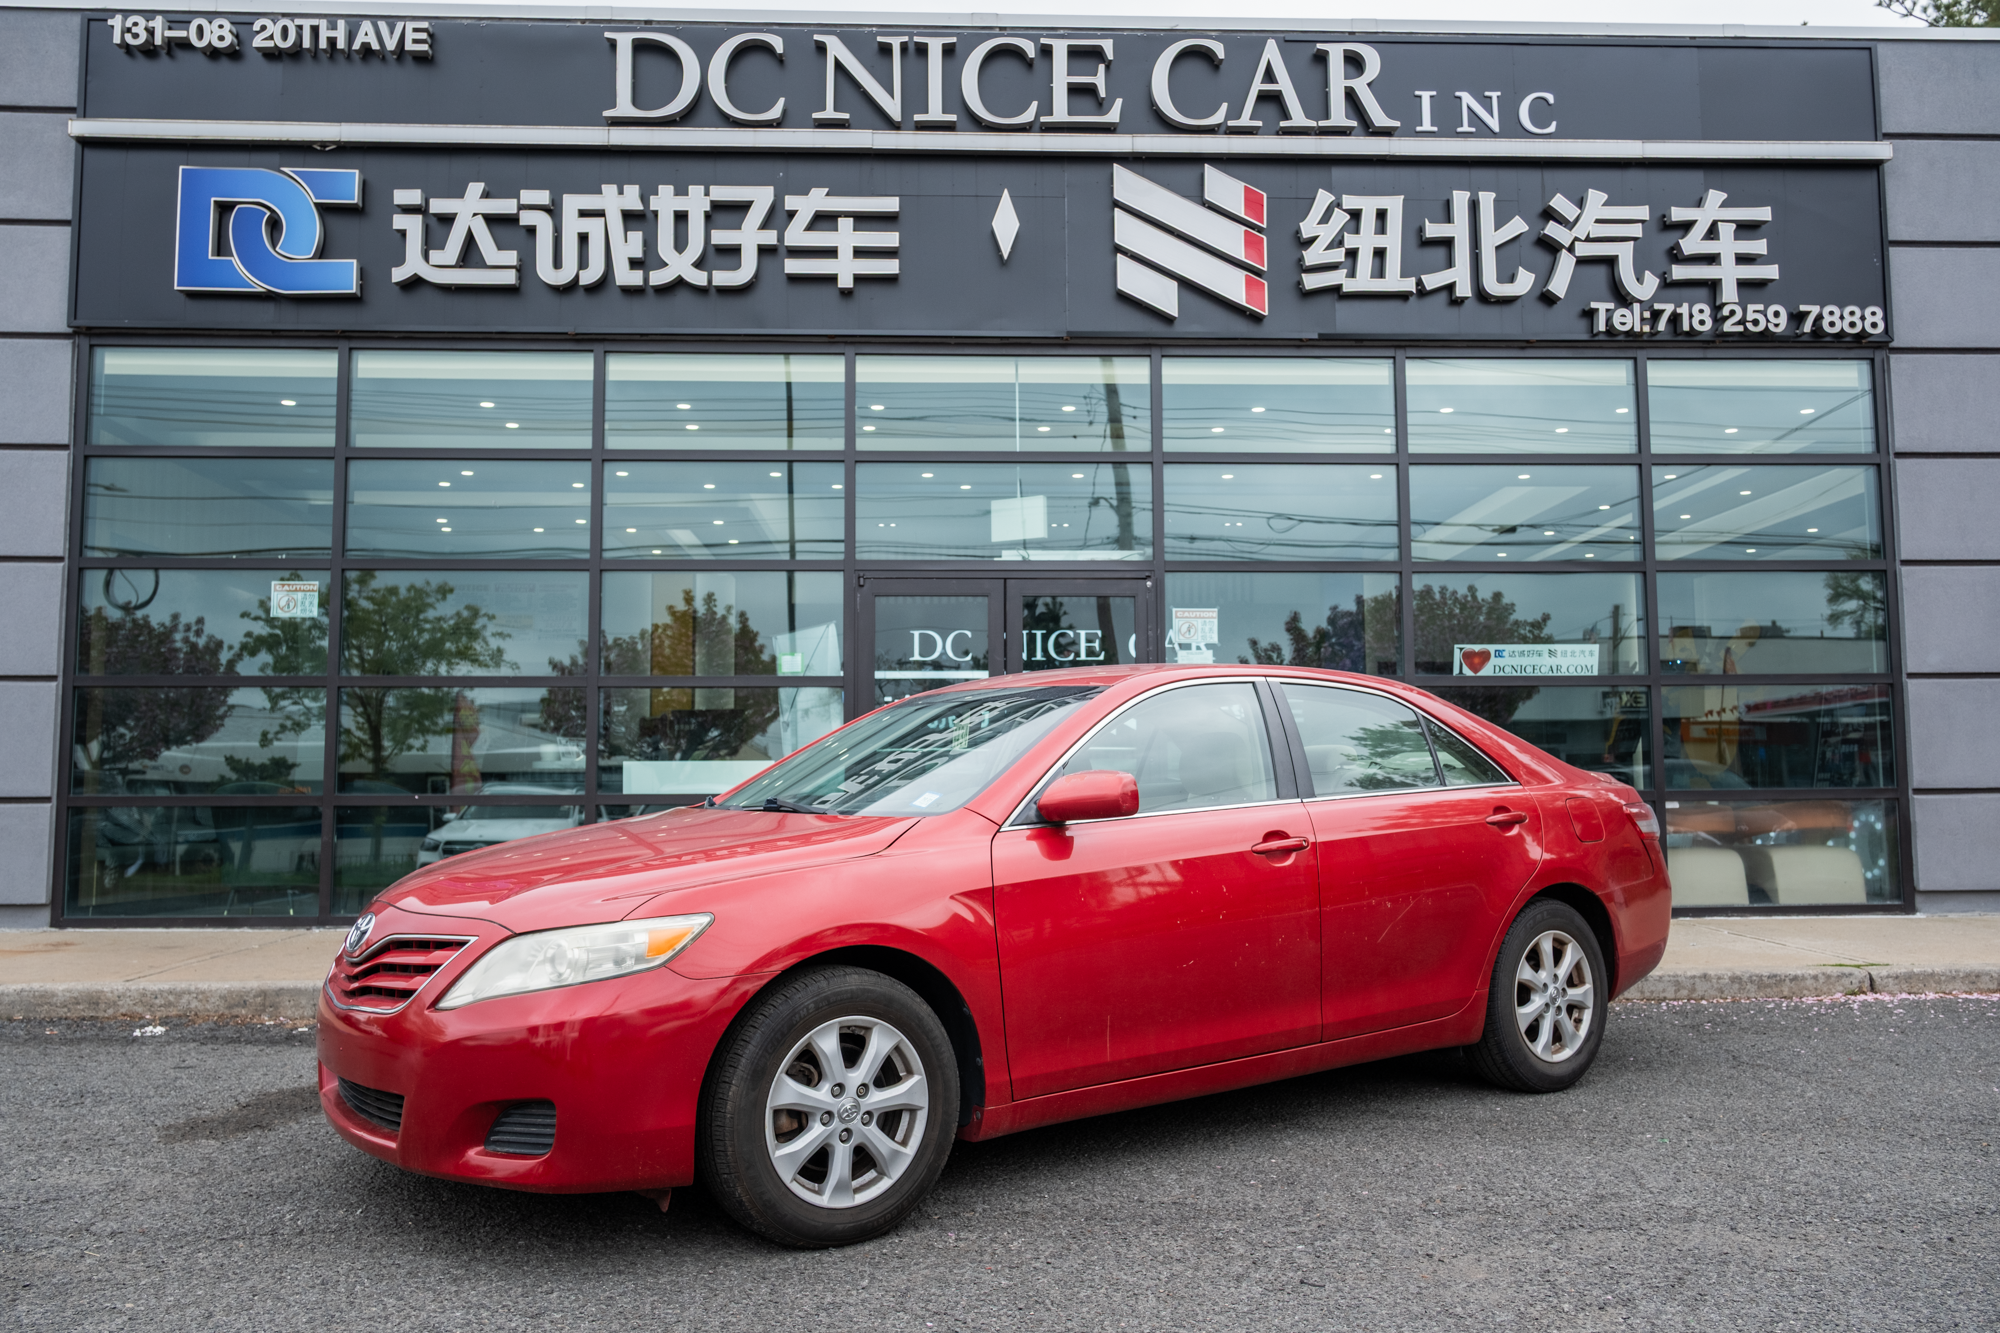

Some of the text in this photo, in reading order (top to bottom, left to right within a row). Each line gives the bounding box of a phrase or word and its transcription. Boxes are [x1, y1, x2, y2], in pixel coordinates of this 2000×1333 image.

[107, 14, 232, 48] 131-08
[352, 20, 429, 50] AVE
[602, 31, 1557, 134] DC NICE CAR INC
[391, 182, 899, 292] 达诚好车
[1298, 188, 1779, 302] 纽北汽车
[1722, 303, 1788, 332] 259
[1799, 304, 1885, 334] 7888
[909, 630, 973, 662] DC
[1508, 649, 1544, 658] 达诚好车
[1560, 649, 1596, 658] 纽北汽车
[1493, 664, 1594, 675] DCNICECAR.COM
